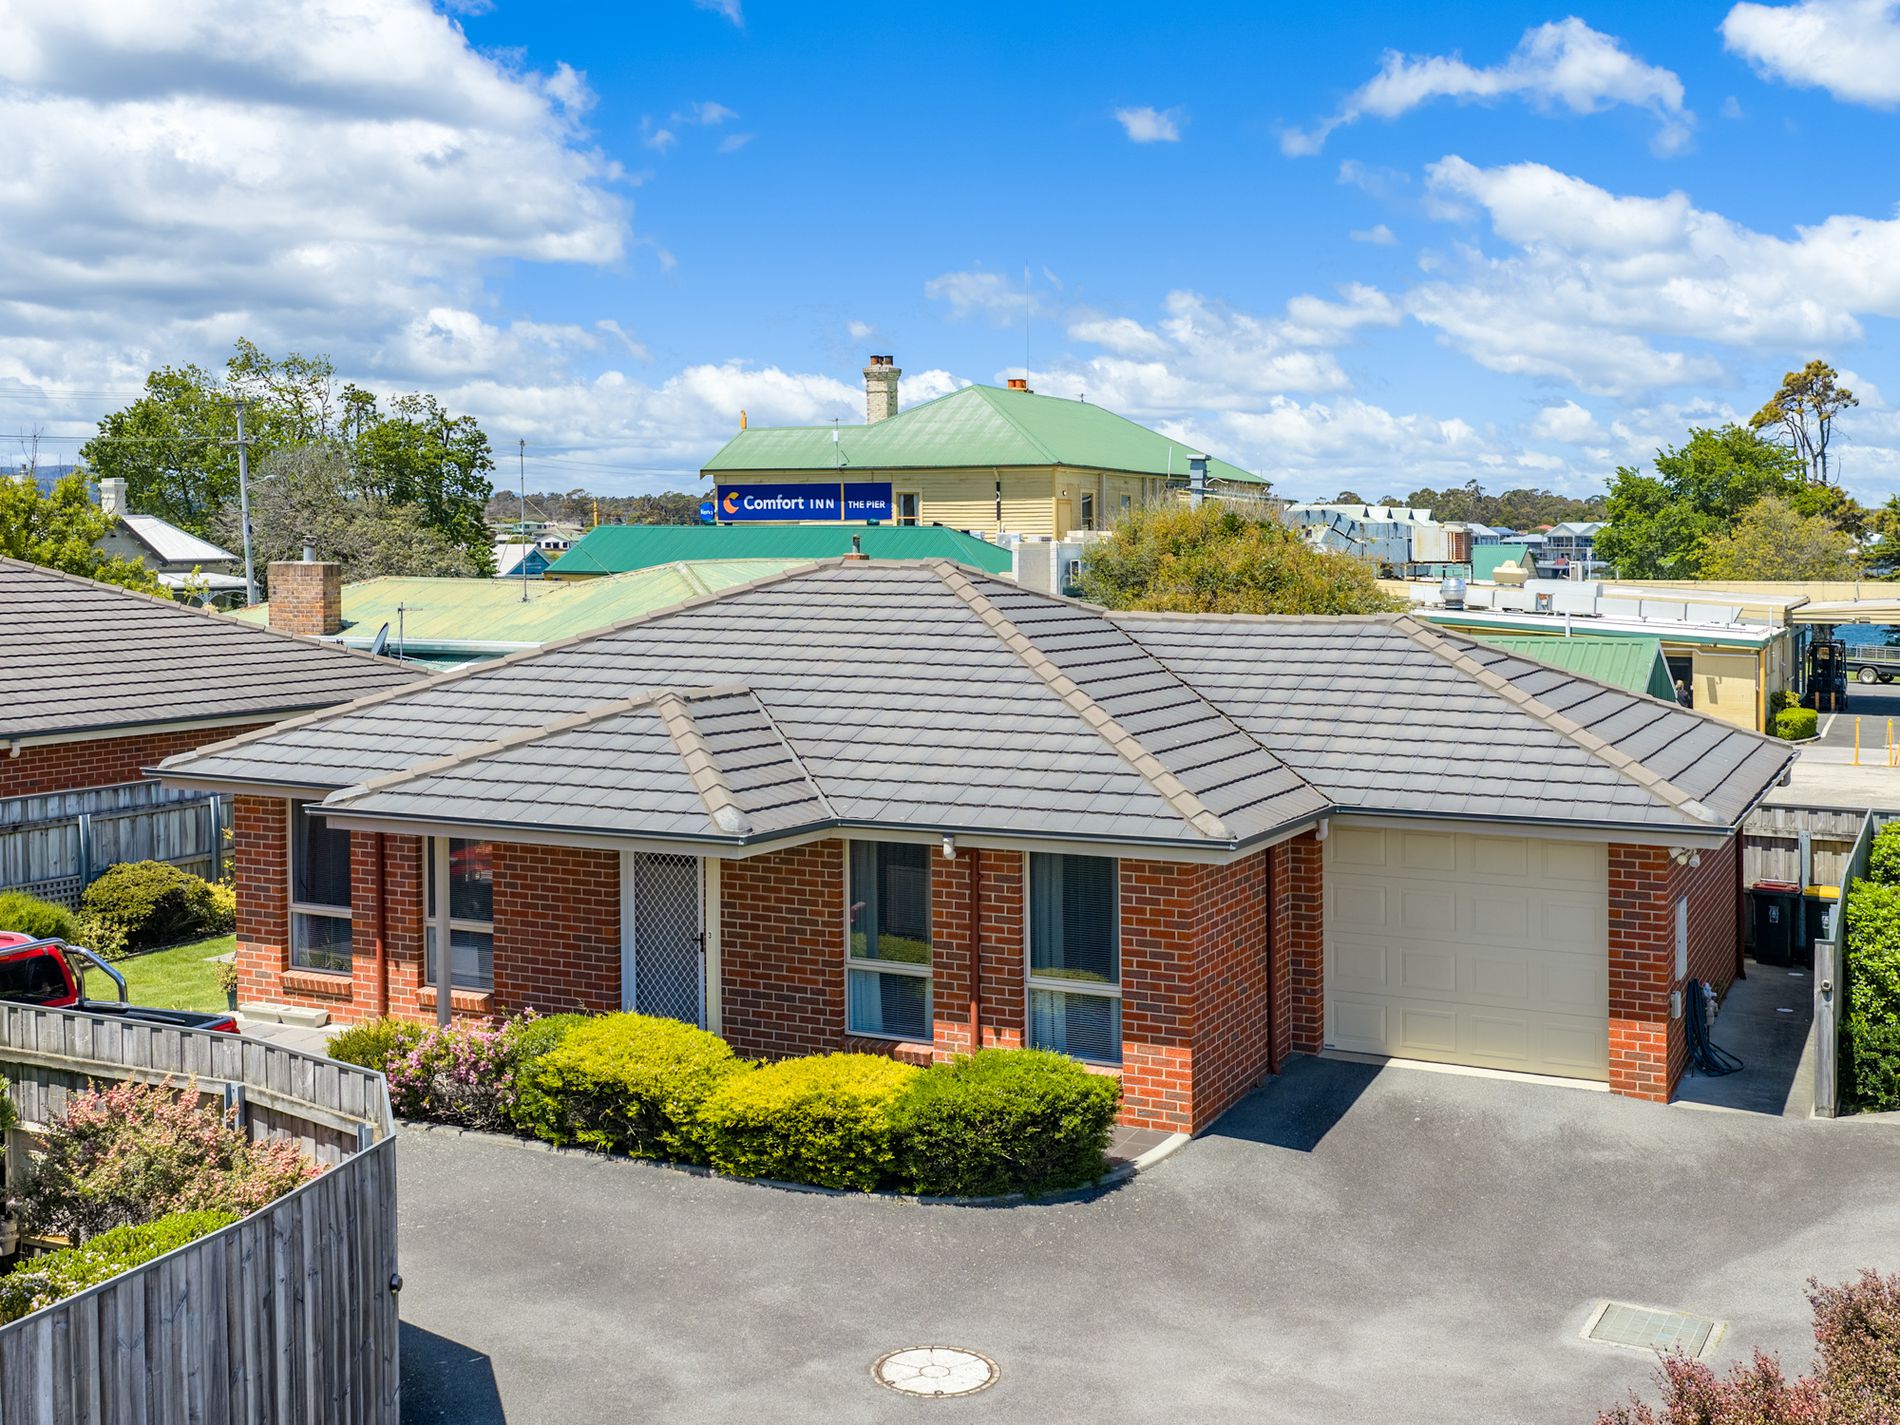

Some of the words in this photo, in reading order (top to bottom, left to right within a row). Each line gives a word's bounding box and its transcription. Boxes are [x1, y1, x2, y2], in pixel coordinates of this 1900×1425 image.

[743, 495, 804, 510] Comfort
[809, 499, 834, 509] INN
[847, 500, 864, 509] THE
[865, 500, 886, 509] PIER
